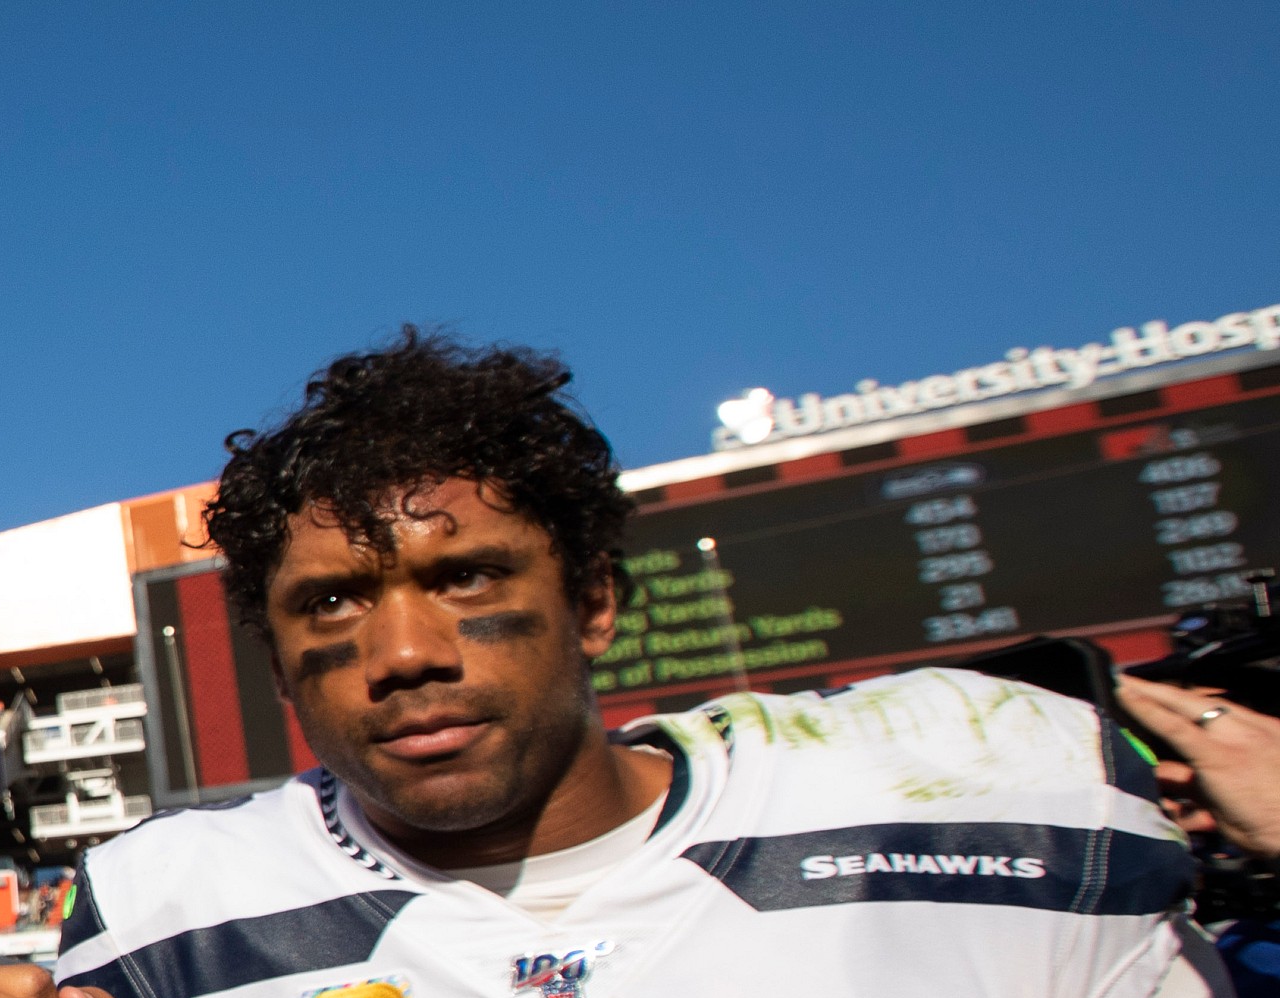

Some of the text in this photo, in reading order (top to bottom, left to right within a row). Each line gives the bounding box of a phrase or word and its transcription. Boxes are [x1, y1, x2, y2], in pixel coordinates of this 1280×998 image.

[774, 343, 1100, 436] University
[645, 568, 734, 599] Yards
[748, 606, 843, 639] Yards
[800, 852, 1047, 880] SEAHAWKS
